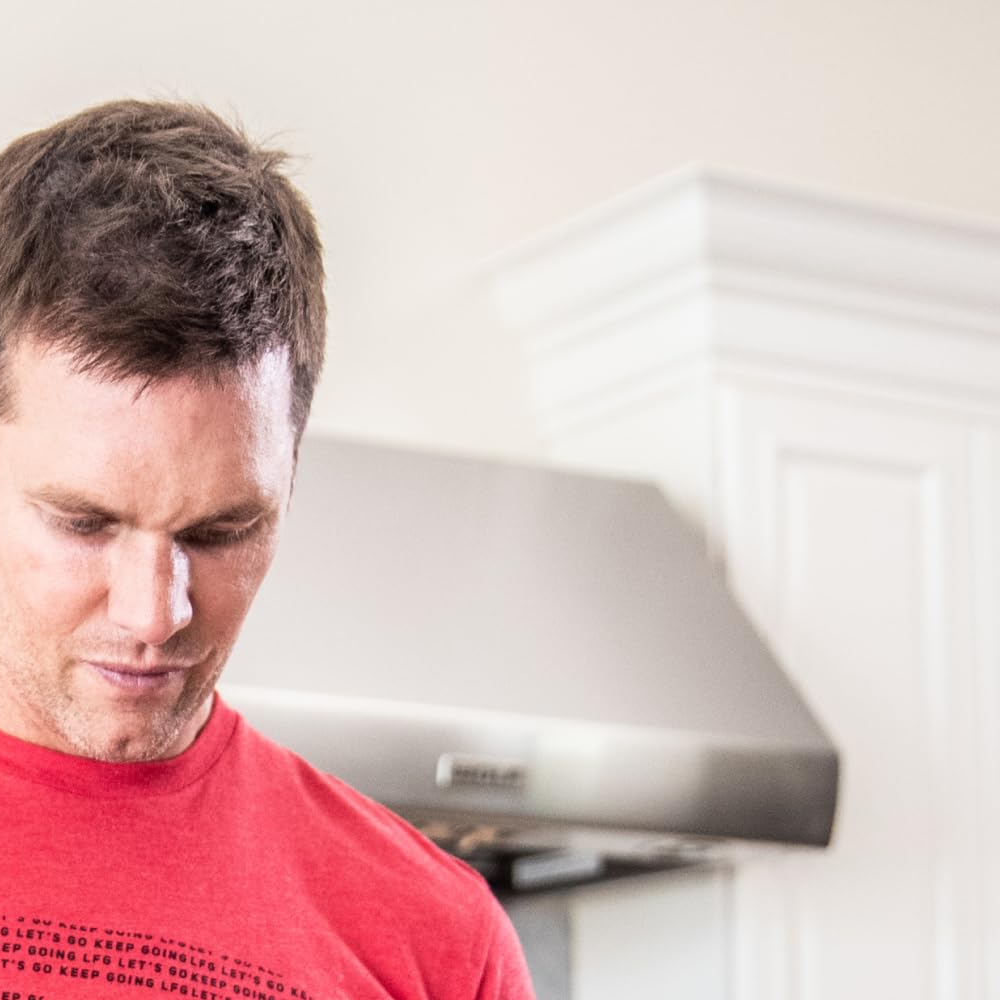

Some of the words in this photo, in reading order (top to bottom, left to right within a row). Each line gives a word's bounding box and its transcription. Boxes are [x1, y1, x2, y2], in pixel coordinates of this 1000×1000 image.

[16, 927, 61, 944] LET'S
[66, 935, 88, 948] GO
[93, 938, 135, 953] KEEP
[221, 965, 261, 986] LET'S
[266, 979, 285, 993] GO
[27, 945, 76, 962] GOING
[82, 953, 112, 966] LFG
[117, 957, 163, 974] LET'S
[31, 961, 53, 974] GO
[59, 965, 100, 980] KEEP
[105, 971, 155, 989] GOING
